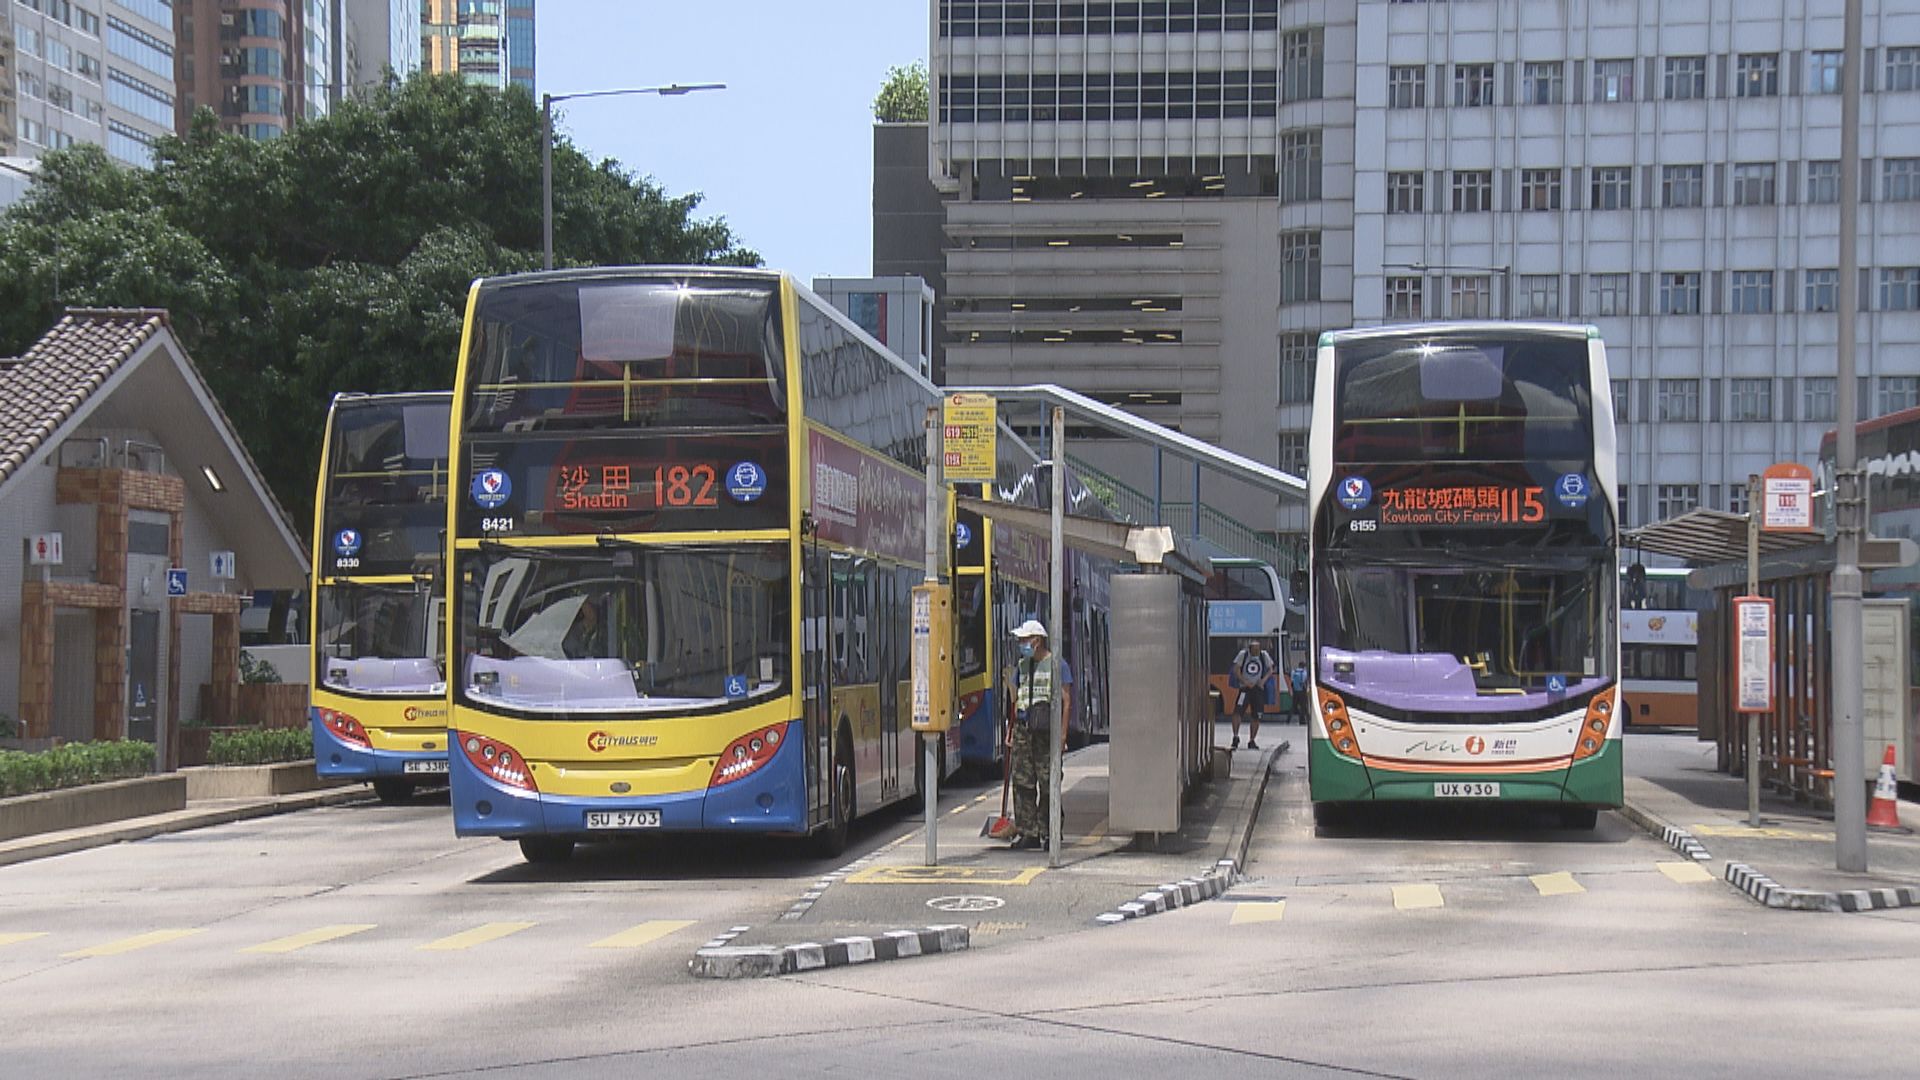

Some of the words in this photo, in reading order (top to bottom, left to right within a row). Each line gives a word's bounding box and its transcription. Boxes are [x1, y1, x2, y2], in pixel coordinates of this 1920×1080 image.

[561, 465, 630, 492] 沙田
[655, 464, 717, 507] 182
[563, 492, 628, 509] Shatin
[1382, 487, 1500, 509] 九龍城碼頭
[1501, 487, 1544, 522] 115
[482, 518, 513, 531] 8421
[1350, 520, 1377, 531] 6155
[1382, 511, 1432, 523] Kowloon
[1435, 511, 1459, 525] City
[1463, 511, 1501, 525] Ferry
[1441, 784, 1459, 795] UX
[1463, 784, 1493, 795] 930
[590, 812, 611, 826] SU
[617, 811, 658, 826] 5703
